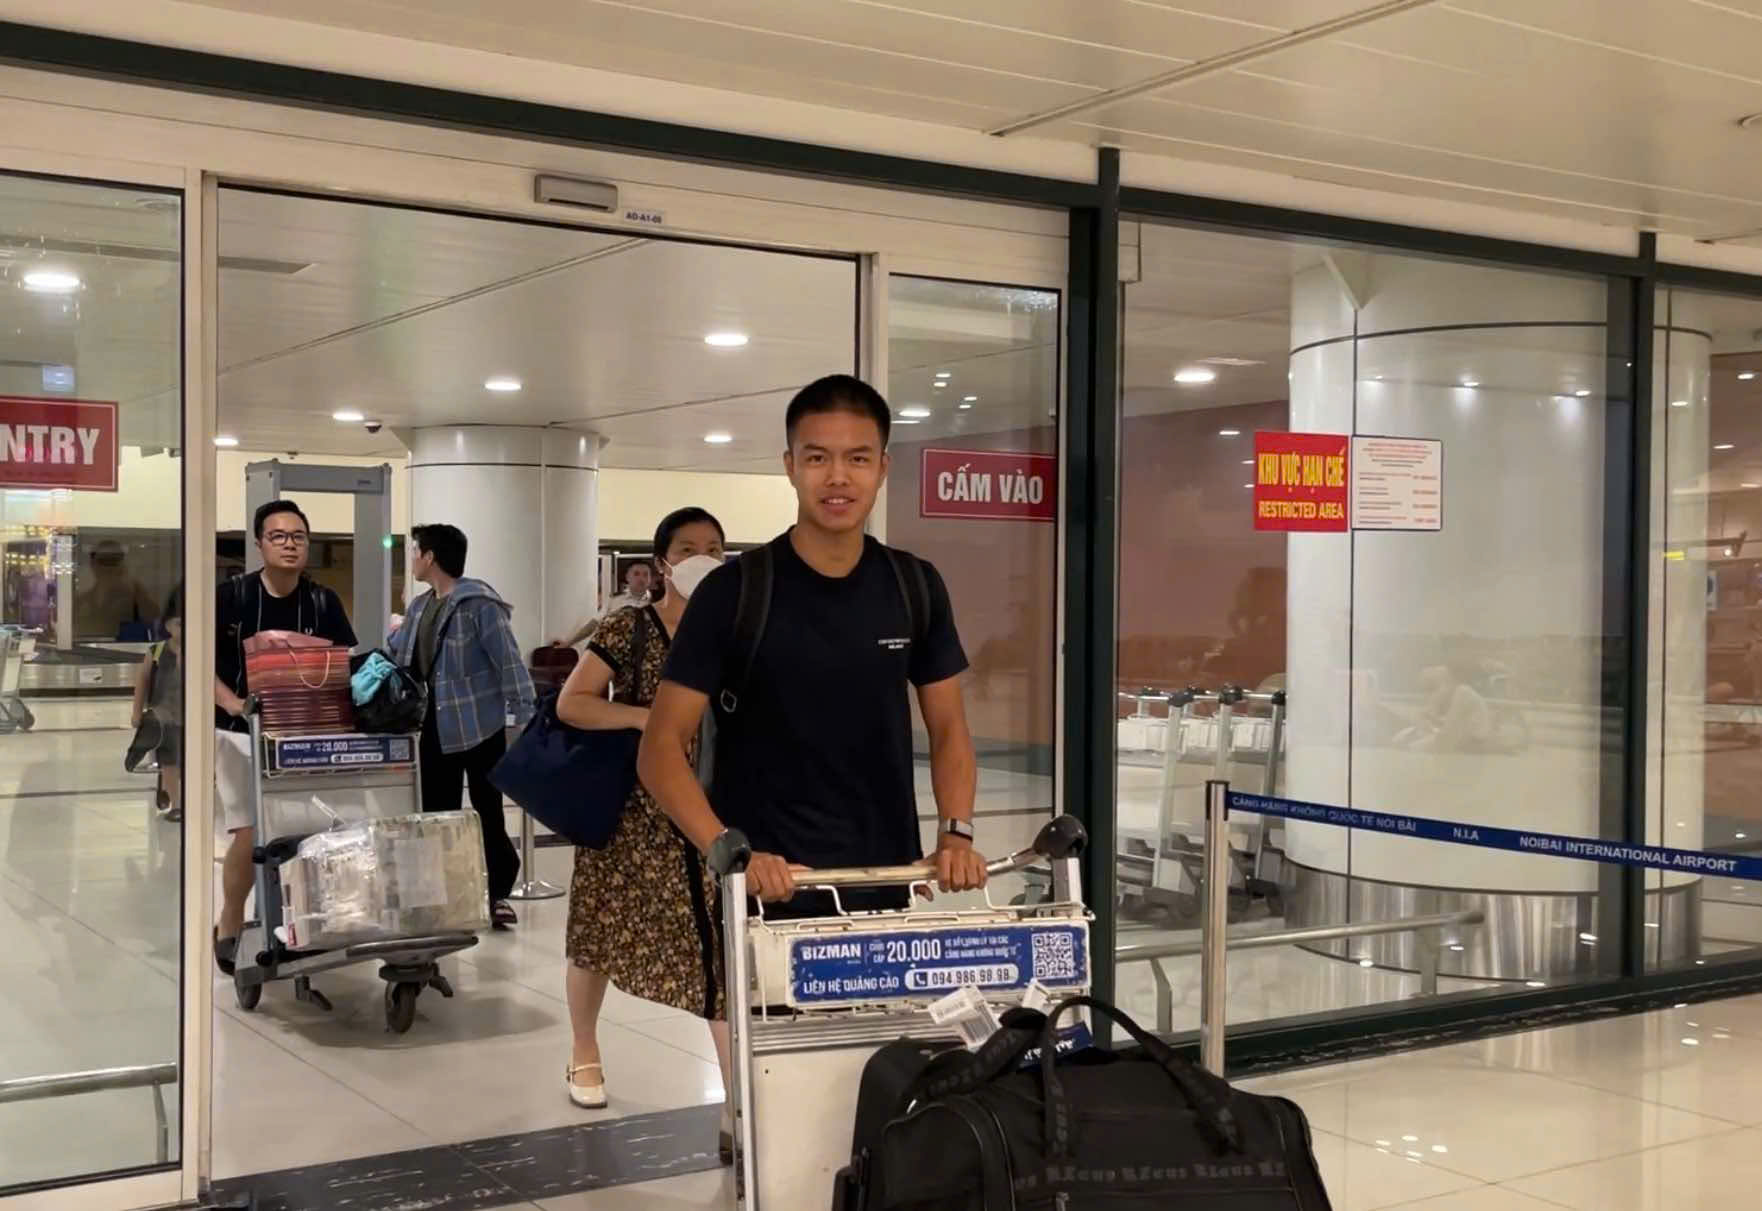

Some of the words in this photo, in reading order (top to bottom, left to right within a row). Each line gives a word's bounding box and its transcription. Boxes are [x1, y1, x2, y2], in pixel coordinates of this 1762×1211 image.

[0, 424, 100, 465] NTRY
[938, 463, 992, 502] CẤM
[999, 469, 1044, 504] VÀO
[1258, 453, 1279, 485] KHU
[1302, 455, 1323, 494] HẠN
[1259, 501, 1316, 518] RESTRICTED
[1319, 502, 1344, 518] AREA
[1453, 827, 1480, 840] N.I.A
[1519, 836, 1562, 850] NOIBAI
[1566, 841, 1670, 865] INTERNATIONAL
[1672, 854, 1737, 872] AIRPORT
[801, 943, 861, 960] BIZMAN
[887, 939, 941, 963] 20.000
[803, 979, 826, 994] LIÊN
[828, 978, 842, 993] HỆ
[843, 976, 878, 992] QUẢNG
